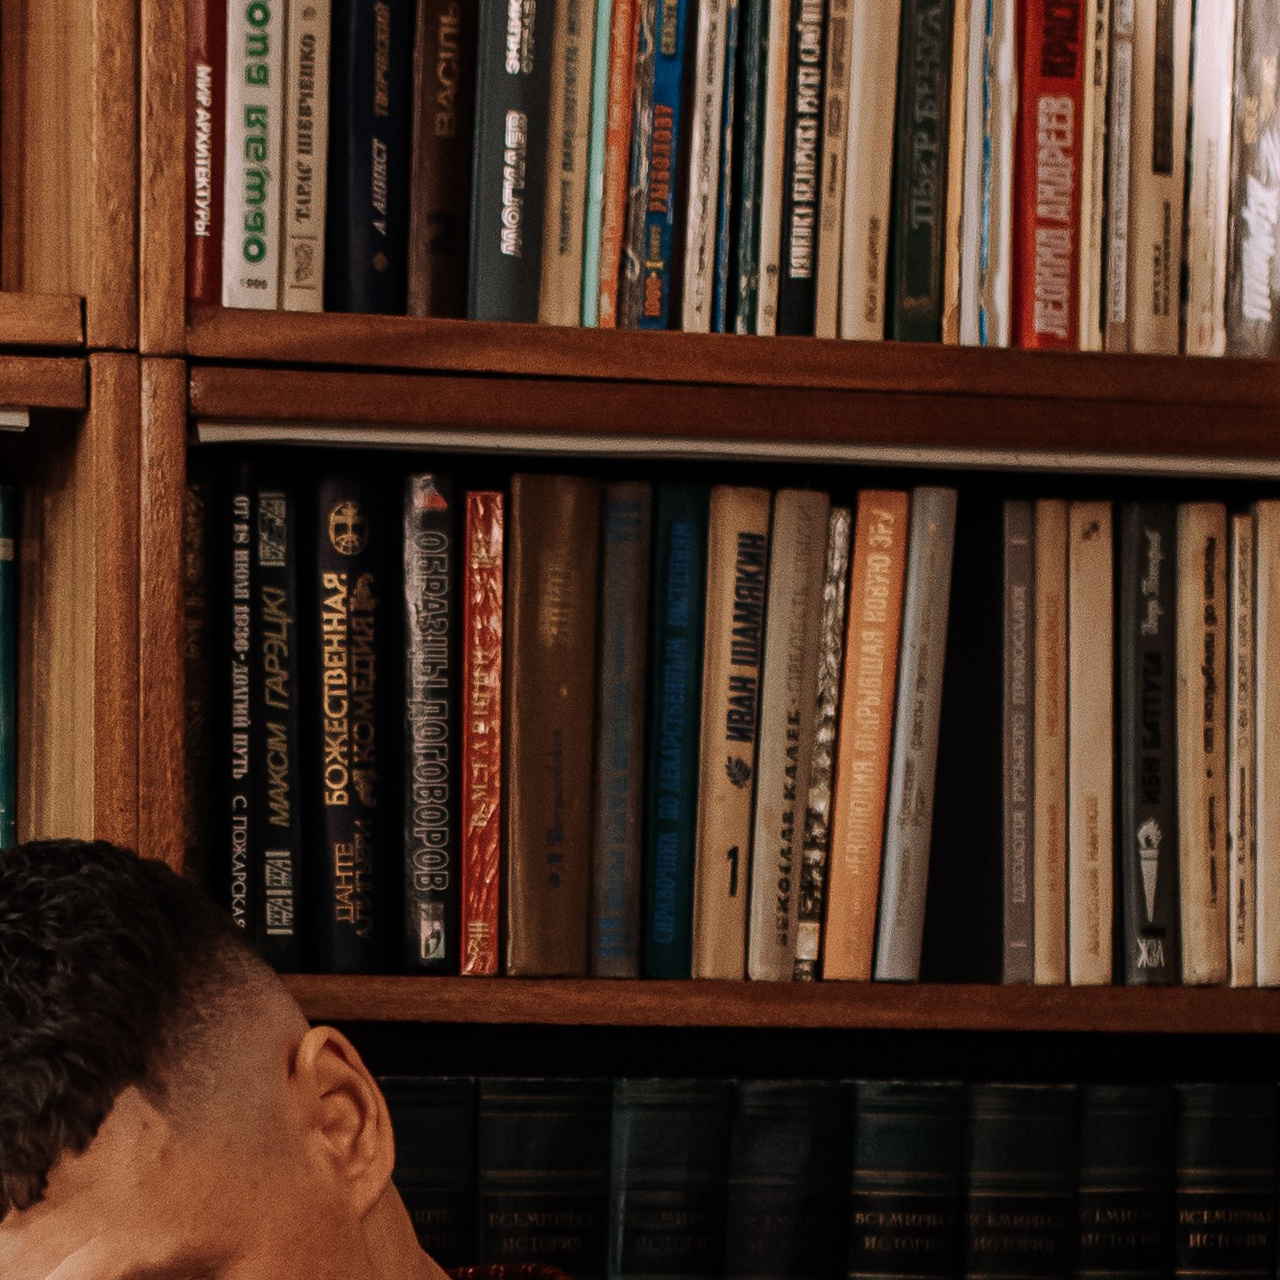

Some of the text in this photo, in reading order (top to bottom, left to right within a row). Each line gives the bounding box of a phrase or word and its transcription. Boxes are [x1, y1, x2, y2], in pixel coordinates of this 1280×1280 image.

[296, 33, 316, 155] ШЕВЧЕНКО
[195, 63, 213, 237] МИР АРХИТЕКТУРЫ
[295, 161, 314, 223] ТАРАС
[372, 136, 388, 215] АНИКСТ
[500, 108, 528, 258] МОГИЛЕВ
[911, 131, 936, 230] ПЬЕР
[1033, 95, 1076, 340] ЛЕОНИД АНДРЕЕВ
[870, 507, 897, 549] ЭРУ
[864, 552, 893, 624] НОВУЮ
[231, 494, 252, 780] ОТ 18 ИЮЛЯ 1936 ДОЛГИЙ ПУТЬ
[725, 531, 767, 743] ИВАН ШАМЯКИН
[1011, 585, 1027, 705] ПРАВОСЛАВИЯ
[260, 584, 295, 828] МАКСІМ ГАРЭЦКІ
[322, 571, 350, 807] БОЖЕСТВЕННАЯ
[351, 614, 377, 764] КОМЕДИЯ
[408, 530, 449, 892] ОБРАЗЦЫ ДОГОВОРОВ
[661, 636, 688, 792] ЛЕКАРСТВЕННЫМ
[852, 629, 886, 751] ОТКРЫВШАЯ
[780, 709, 803, 801] КАЛЕБ
[1011, 709, 1027, 803] РУССКОГО
[1141, 757, 1161, 805] ИБН
[657, 796, 679, 820] ПО
[231, 815, 248, 929] ПОЖАРСКАЯ
[335, 842, 355, 924] ДАНТЕ
[652, 830, 676, 945] СПРАВОЧНИК
[727, 845, 740, 898] 1
[489, 1212, 598, 1229] ВСЕМИРНАЯ
[502, 1237, 582, 1254] ИСТОРИЯ
[856, 1212, 954, 1229] ВСЕМИРНАЯ
[969, 1213, 1065, 1230] ВСЕМИРНАЯ
[1178, 1209, 1274, 1226] ВСЕМИРНАЯ
[1187, 1231, 1268, 1249] ИСТОРИЯ
